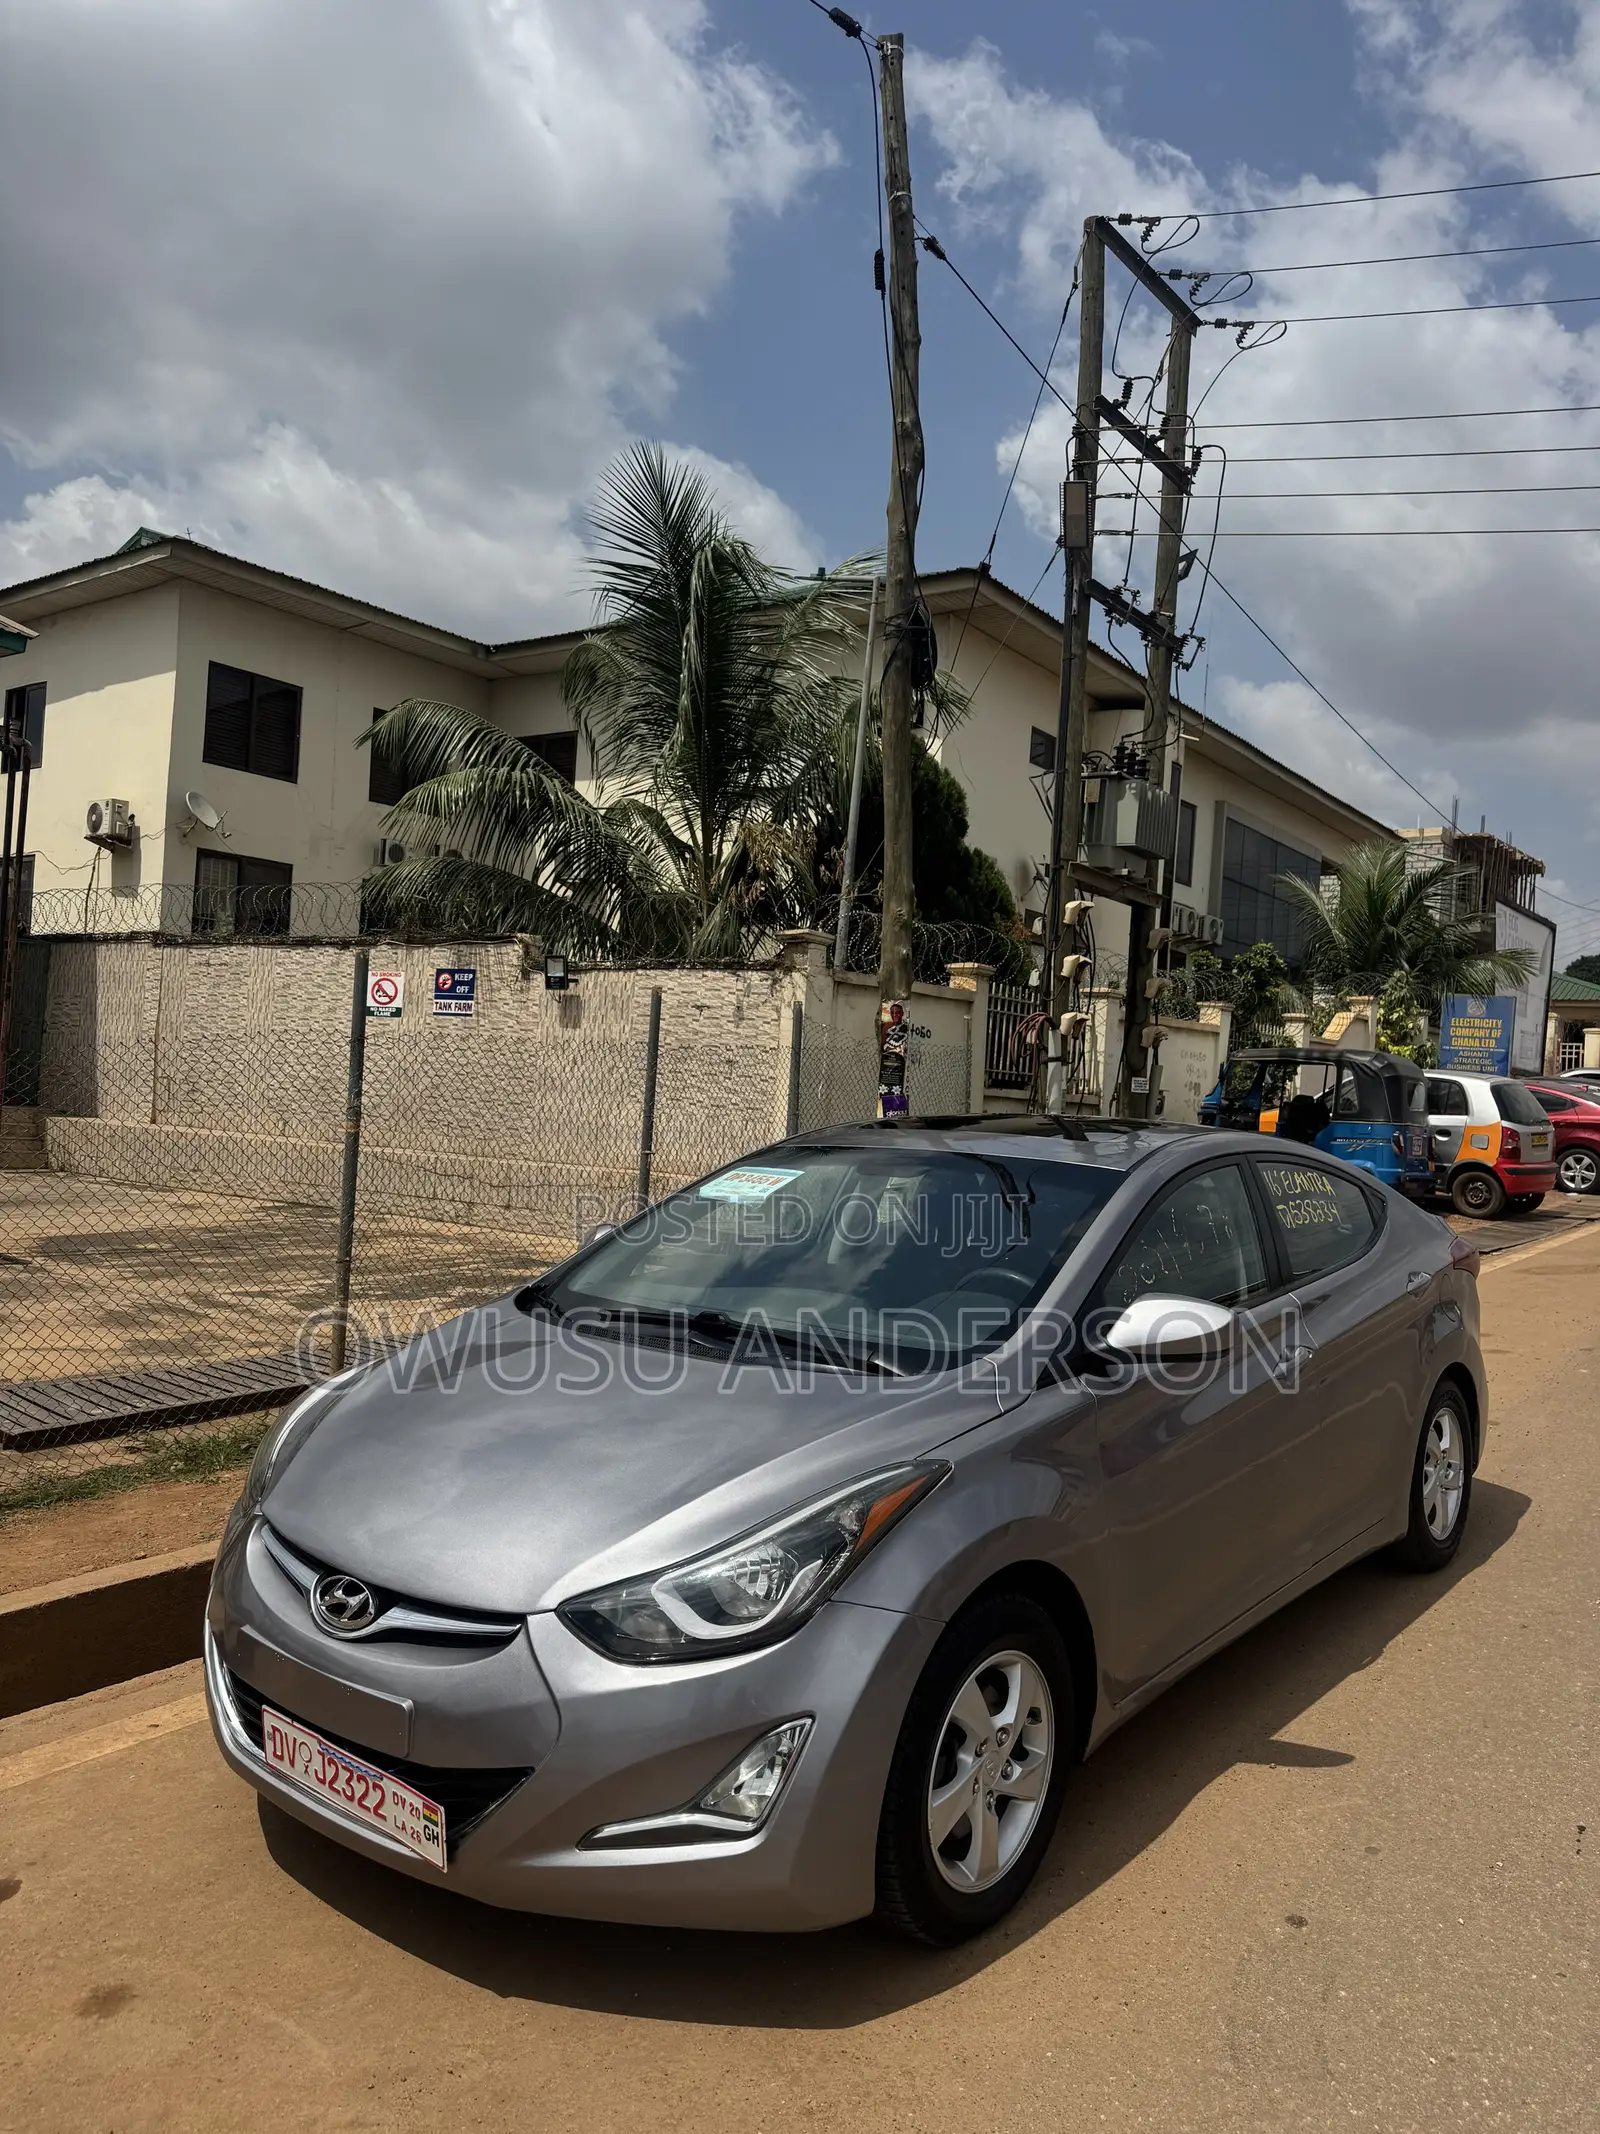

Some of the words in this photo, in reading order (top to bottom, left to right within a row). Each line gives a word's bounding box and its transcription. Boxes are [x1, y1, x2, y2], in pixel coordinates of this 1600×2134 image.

[454, 973, 473, 981] KEEP
[456, 985, 470, 993] OFF
[435, 1001, 453, 1011] TANK
[454, 1002, 473, 1012] FARM
[1450, 1017, 1503, 1029] ELECTRICITY
[1450, 1027, 1490, 1038] COMPANY
[1491, 1029, 1502, 1038] OF
[1451, 1037, 1480, 1047] GHANA
[1453, 1057, 1492, 1065] STRATEGIC
[1446, 1063, 1481, 1071] BUSINESS
[1280, 1170, 1337, 1198] ELANTRA
[271, 1724, 297, 1769] DV
[313, 1748, 388, 1822] J2322
[392, 1790, 406, 1811] DV
[408, 1801, 421, 1821] 20
[393, 1814, 408, 1836] LA
[410, 1825, 422, 1844] 26
[423, 1823, 440, 1849] GH
